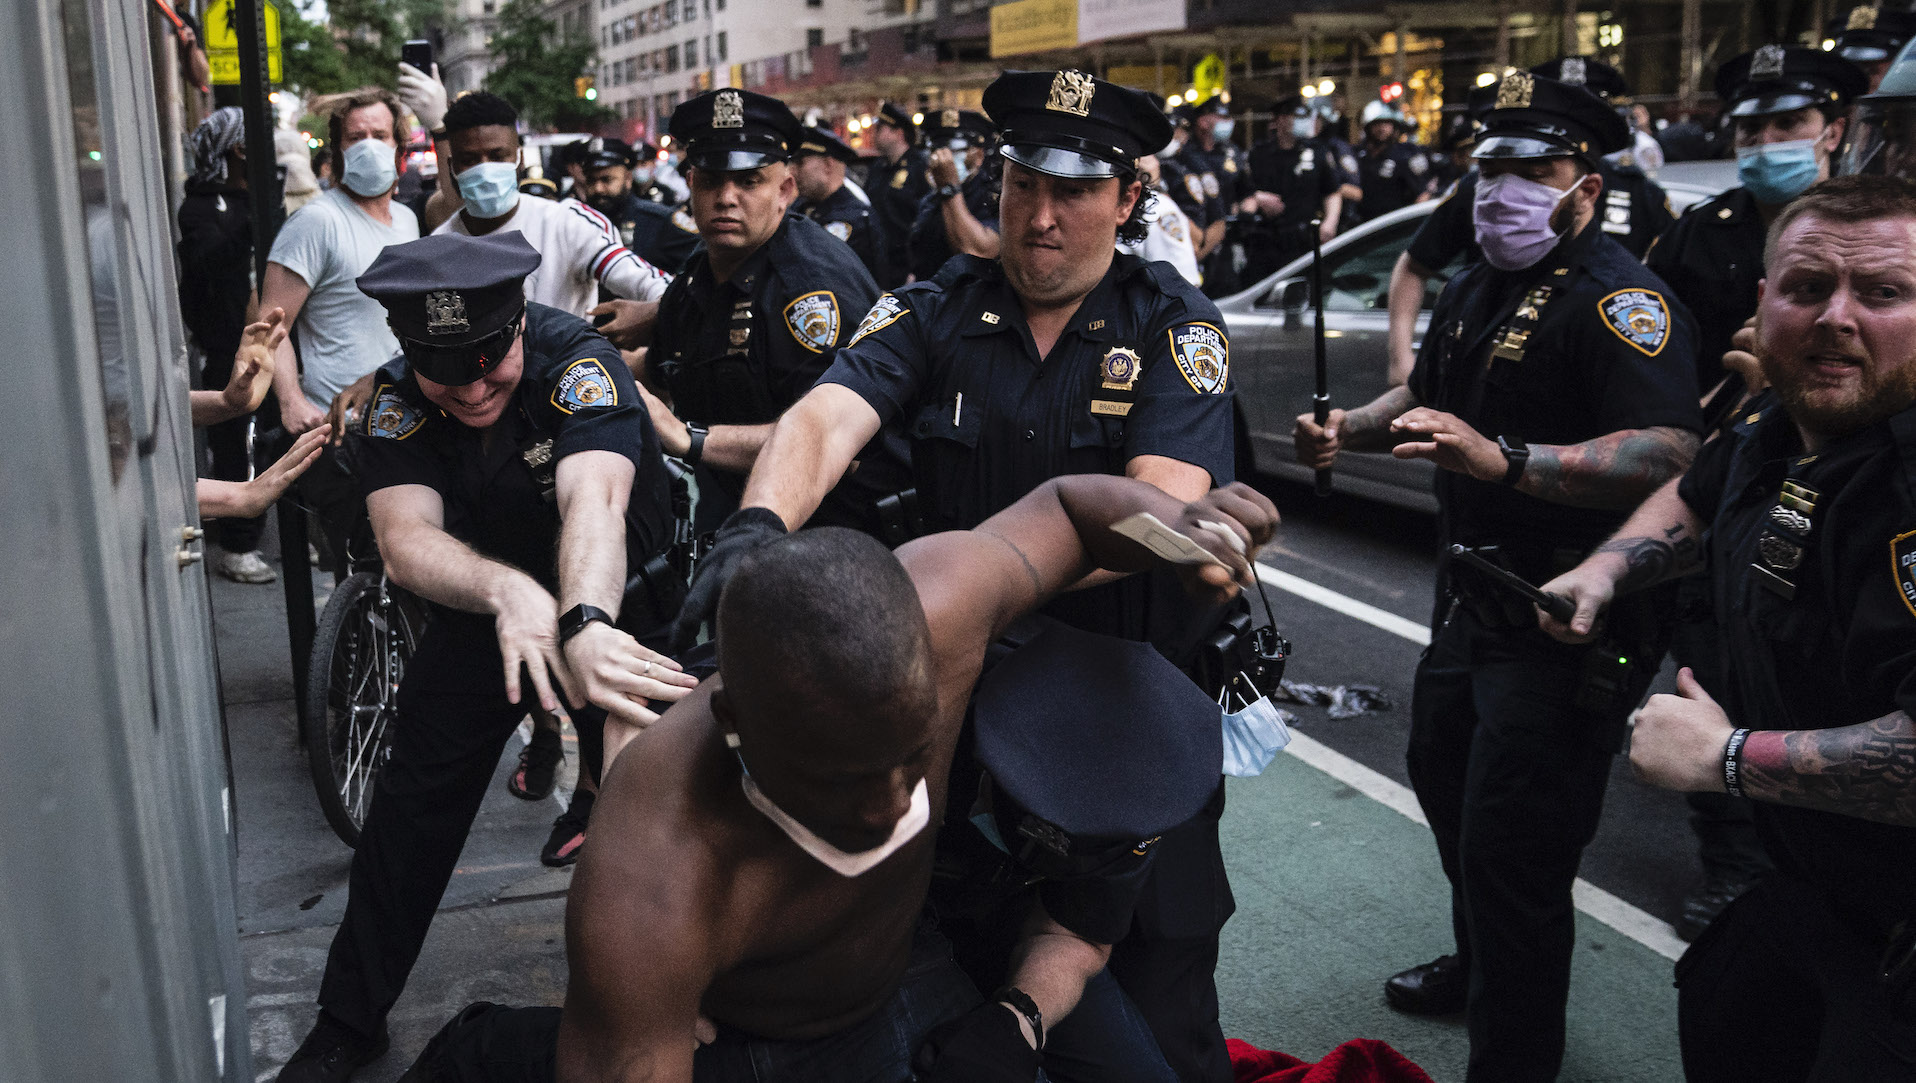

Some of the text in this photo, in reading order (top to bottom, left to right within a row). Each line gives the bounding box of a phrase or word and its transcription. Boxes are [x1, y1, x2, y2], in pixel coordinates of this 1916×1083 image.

[793, 295, 819, 311] POLICE
[1177, 335, 1227, 358] DEPARTMENT
[1189, 327, 1220, 343] POLICE
[558, 364, 584, 388] POLICE
[1177, 353, 1203, 389] CITY OF
[558, 366, 601, 404] DEPARTMENT
[1098, 403, 1127, 412] BRADLEY
